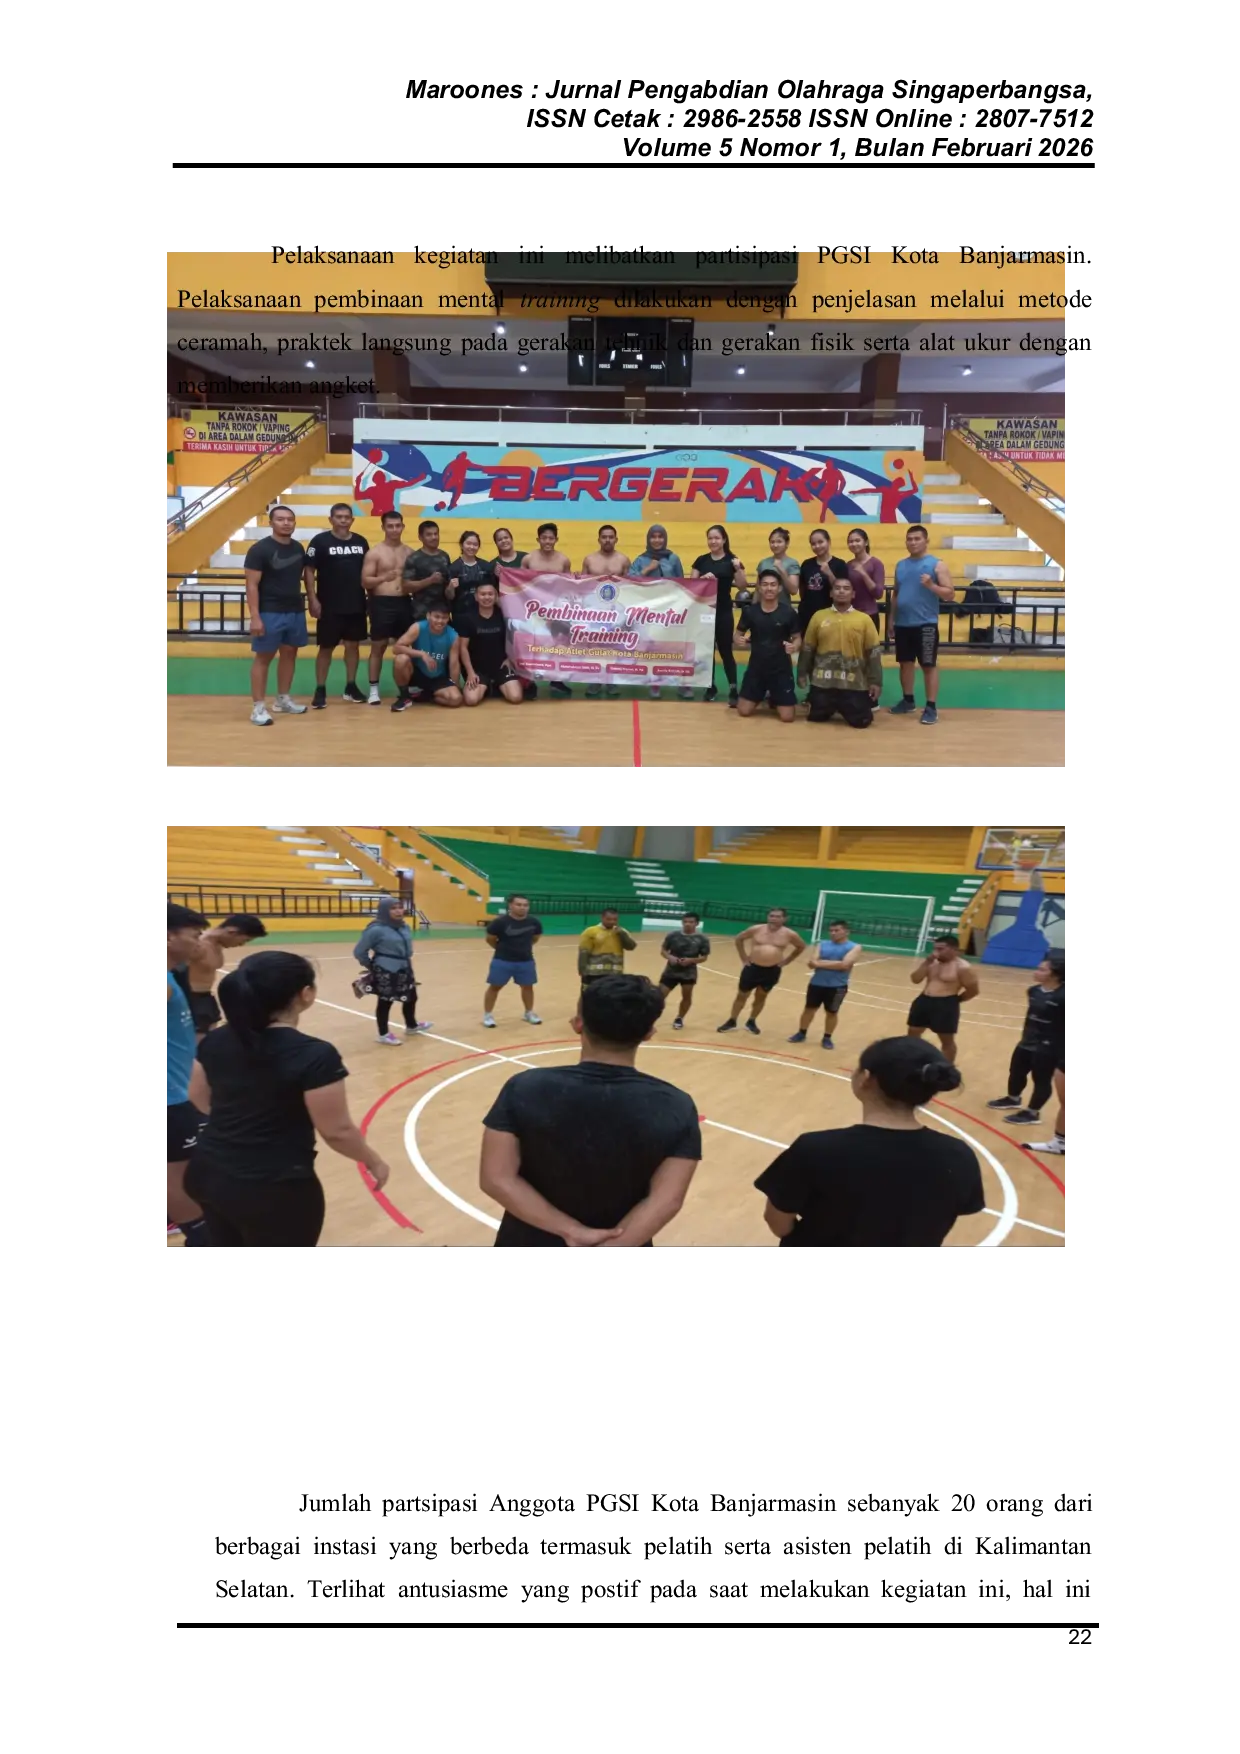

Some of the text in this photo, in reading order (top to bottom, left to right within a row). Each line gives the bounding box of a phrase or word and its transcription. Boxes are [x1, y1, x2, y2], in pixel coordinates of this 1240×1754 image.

[218, 411, 278, 423] KAWASAN
[207, 422, 230, 431] TANPA
[232, 423, 258, 432] ROKOK
[263, 423, 290, 432] VAPING
[996, 419, 1058, 429] KAWASAN
[199, 432, 207, 440] DI
[208, 432, 228, 441] AREA
[230, 433, 254, 441] DALAM
[983, 430, 1007, 439] TANPA
[1009, 430, 1035, 439] ROKOK
[1041, 430, 1064, 439] VAPIN
[187, 442, 212, 451] TERIMA
[213, 443, 233, 451] KASIH
[234, 443, 257, 452] UNTUK
[1006, 440, 1031, 449] DALAM
[1033, 440, 1065, 449] GEDUNG
[1011, 451, 1033, 460] UNTUK
[1035, 451, 1053, 460] TIDAK
[488, 466, 825, 503] BERGERAK
[329, 545, 364, 556] COACH
[525, 601, 688, 627] Pembinaan Mental
[570, 625, 639, 649] Training
[527, 645, 565, 656] Terhadap
[566, 647, 586, 655] Atlet
[634, 650, 684, 661] Banjarmasin
